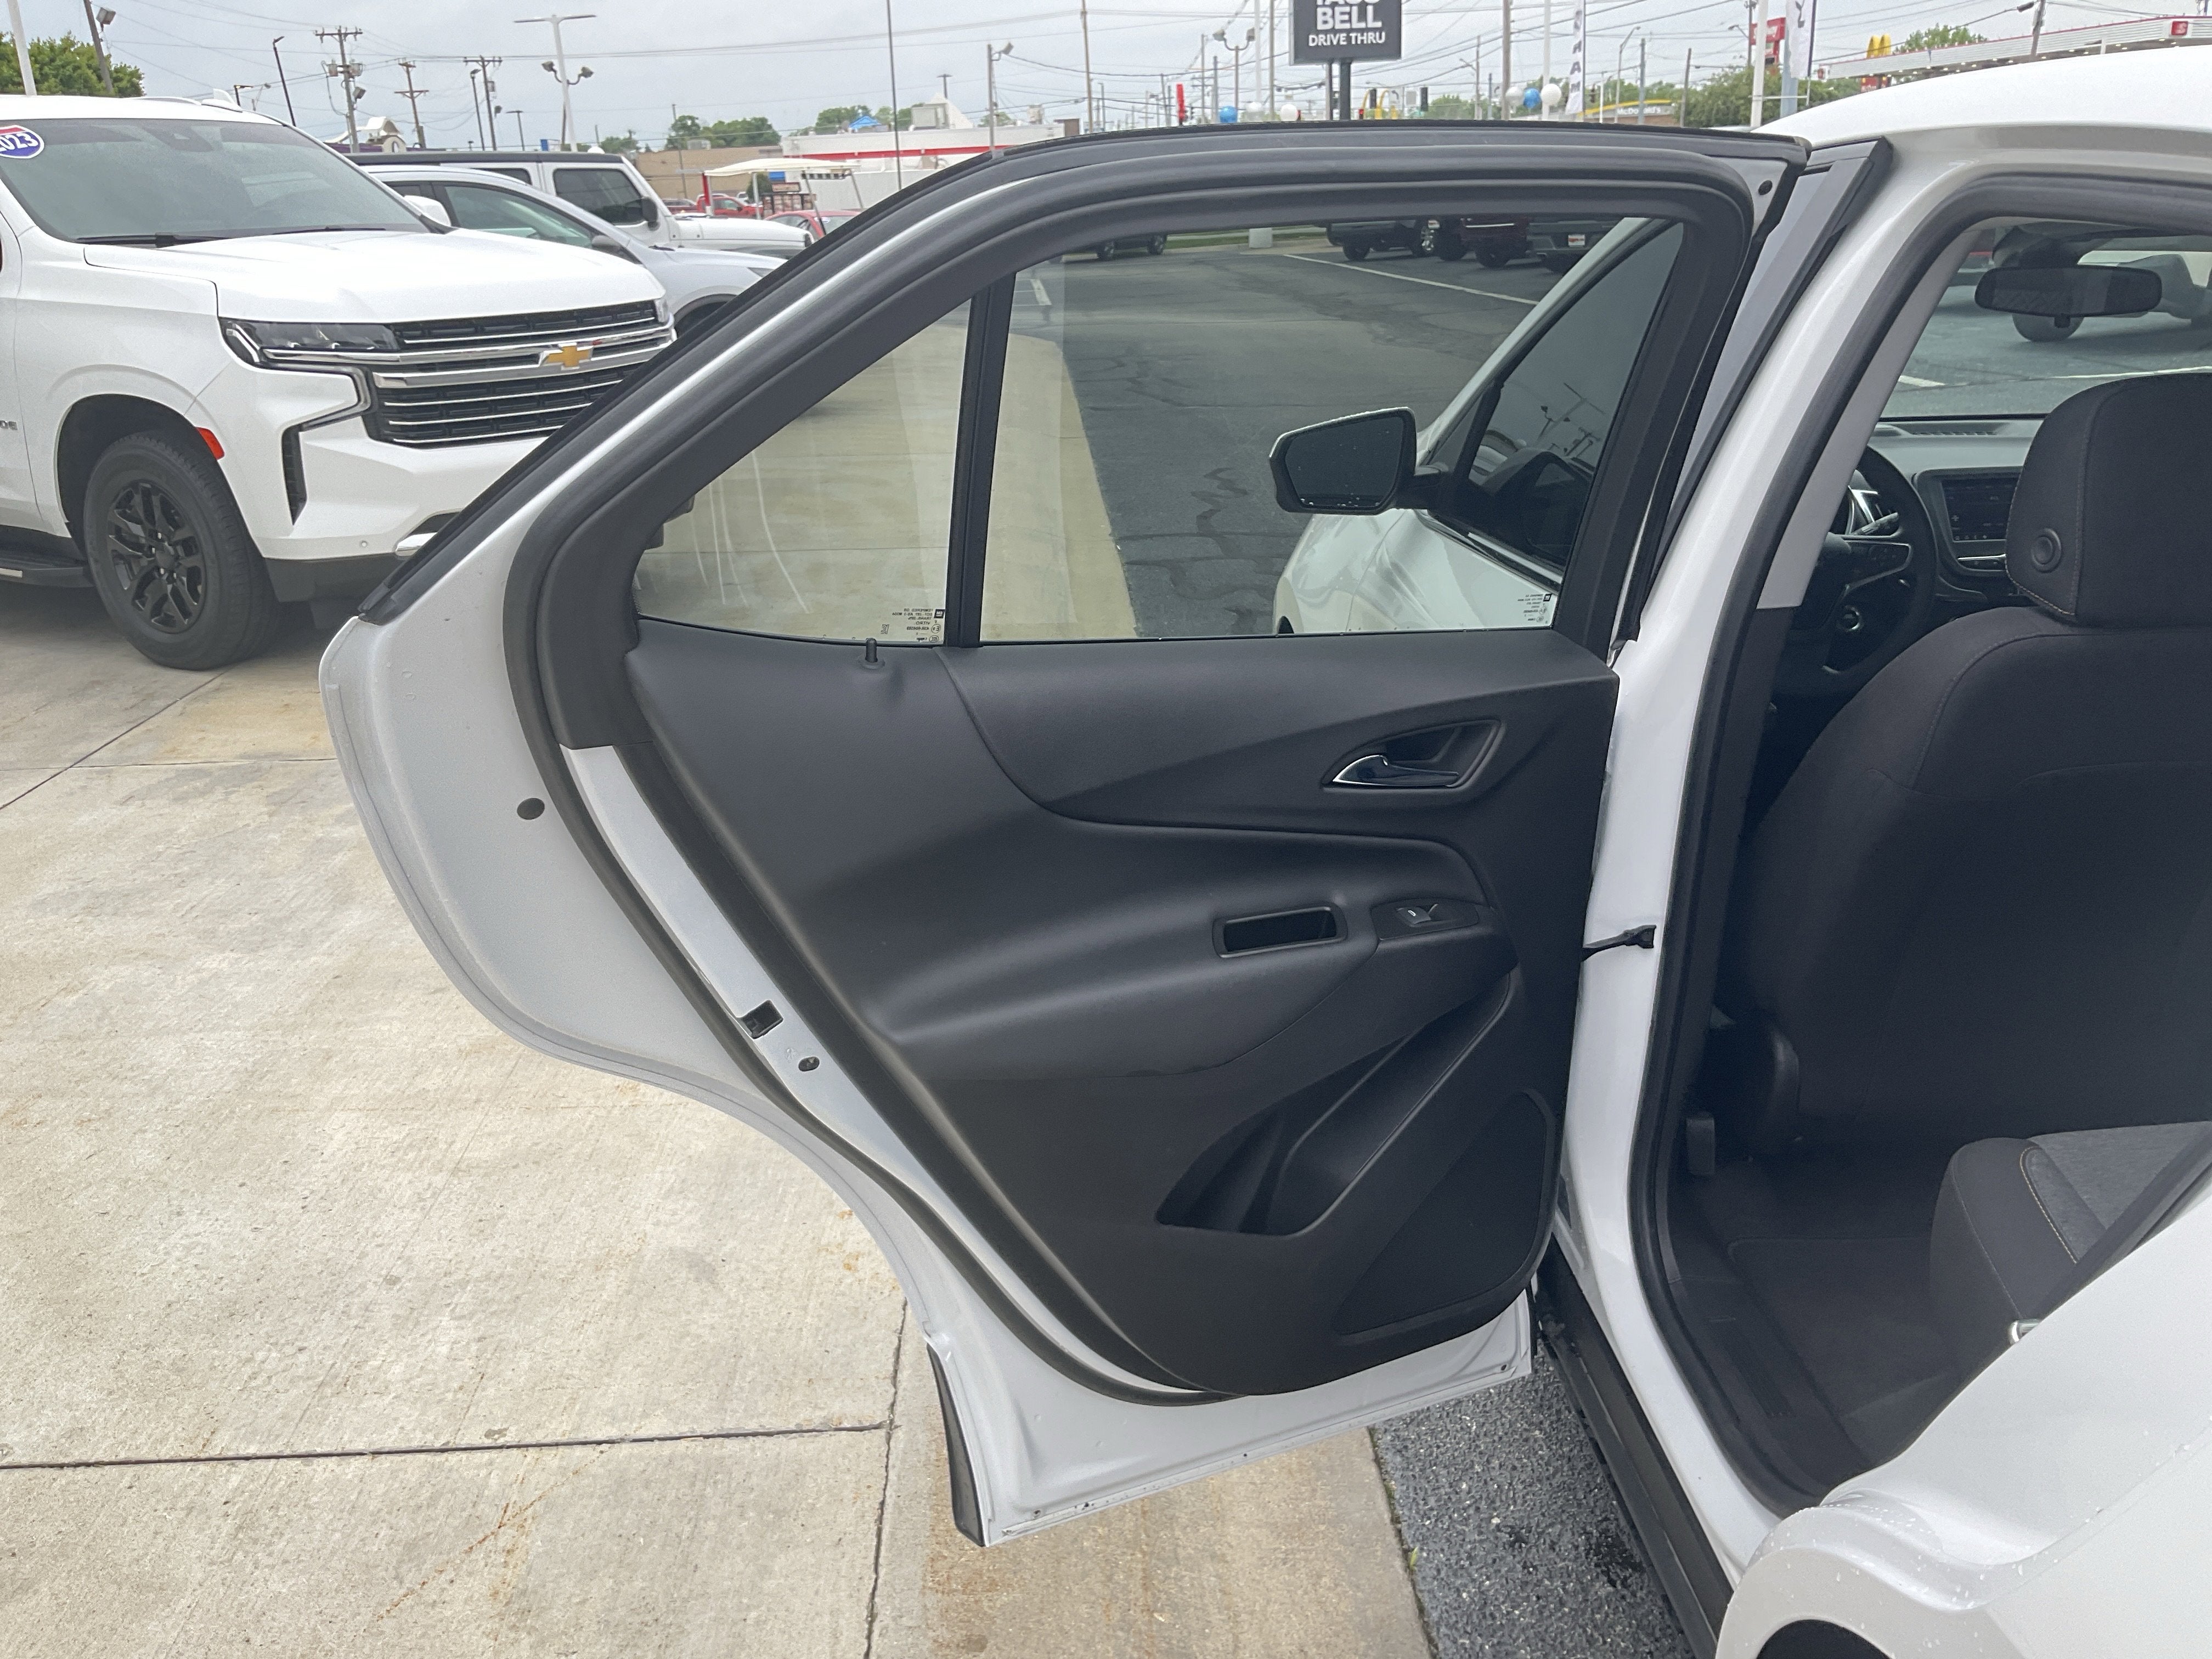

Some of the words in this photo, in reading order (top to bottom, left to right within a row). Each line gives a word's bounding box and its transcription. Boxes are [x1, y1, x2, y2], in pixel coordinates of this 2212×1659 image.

[1317, 5, 1383, 30] BELL
[1308, 33, 1347, 47] DRIVE
[1349, 31, 1386, 44] THRU
[1617, 106, 1661, 115] McDoald's
